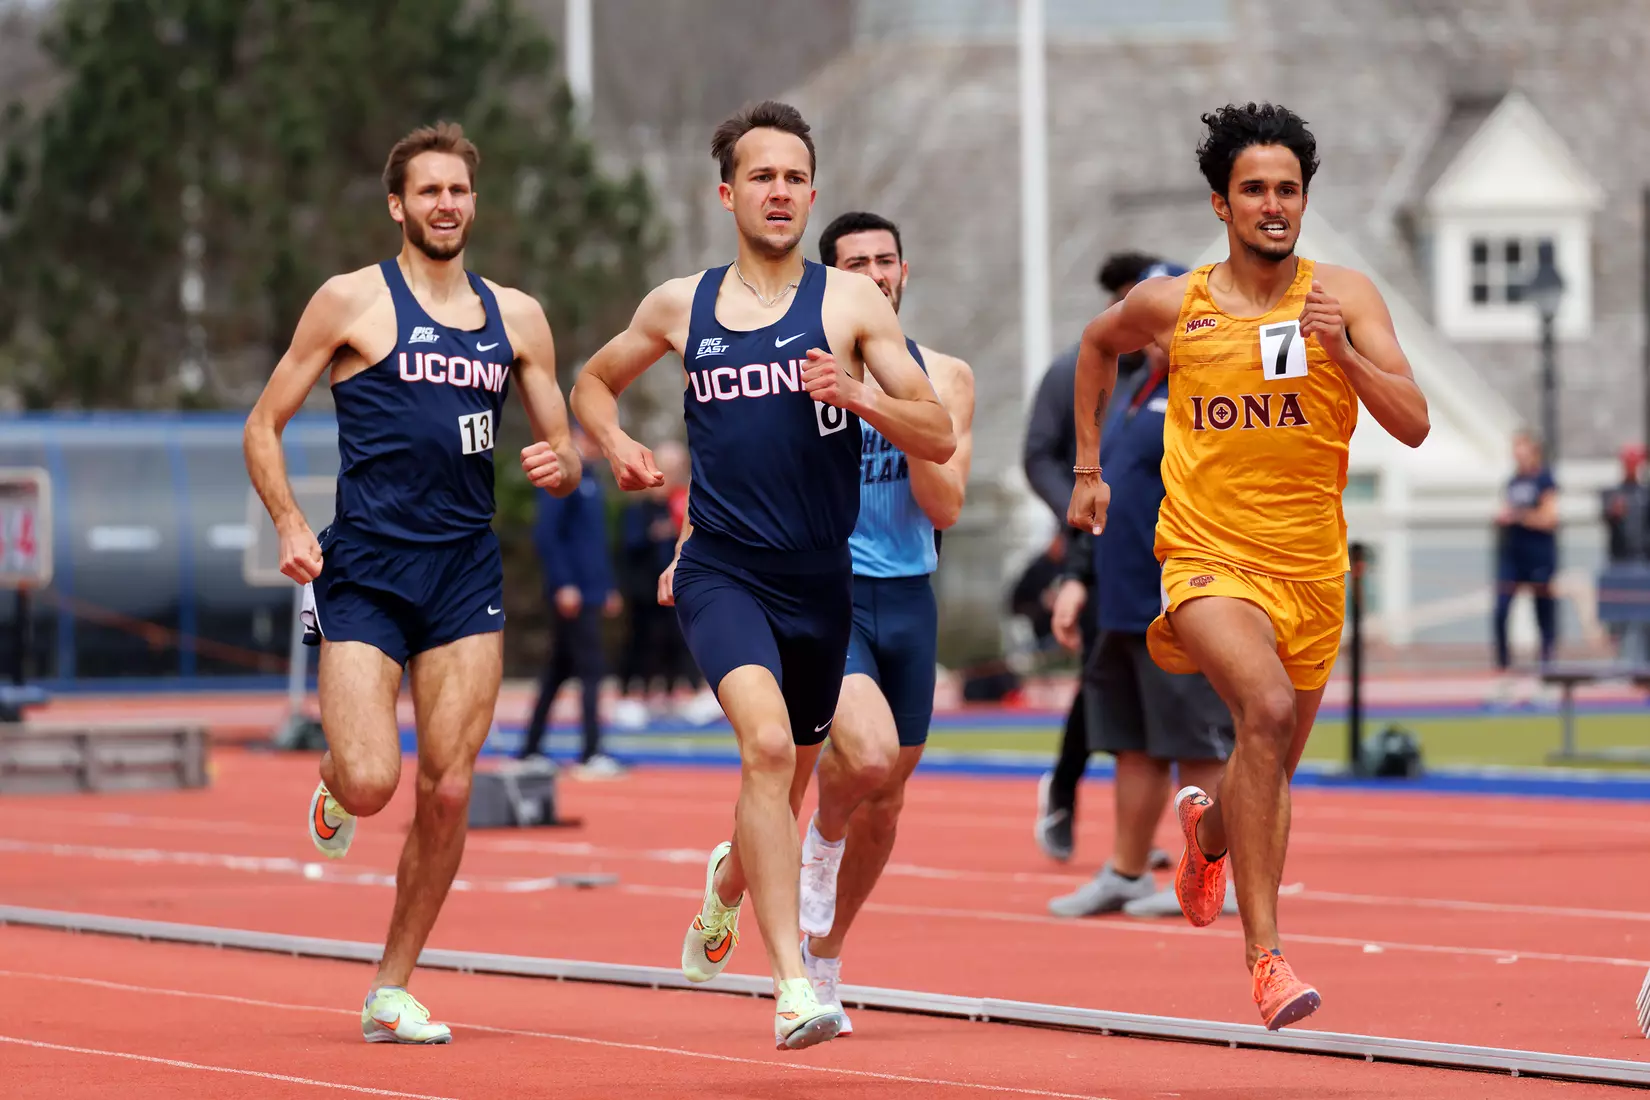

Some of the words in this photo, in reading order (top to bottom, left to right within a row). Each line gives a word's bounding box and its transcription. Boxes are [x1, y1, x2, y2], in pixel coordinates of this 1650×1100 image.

[412, 326, 435, 334] BIG
[1184, 318, 1217, 335] MAAC
[409, 333, 440, 342] EAST
[700, 337, 723, 347] BIG
[696, 344, 730, 355] EAST
[1264, 324, 1297, 376] 7
[398, 352, 510, 393] UCONN
[1189, 391, 1310, 432] IONA
[463, 414, 490, 453] 13
